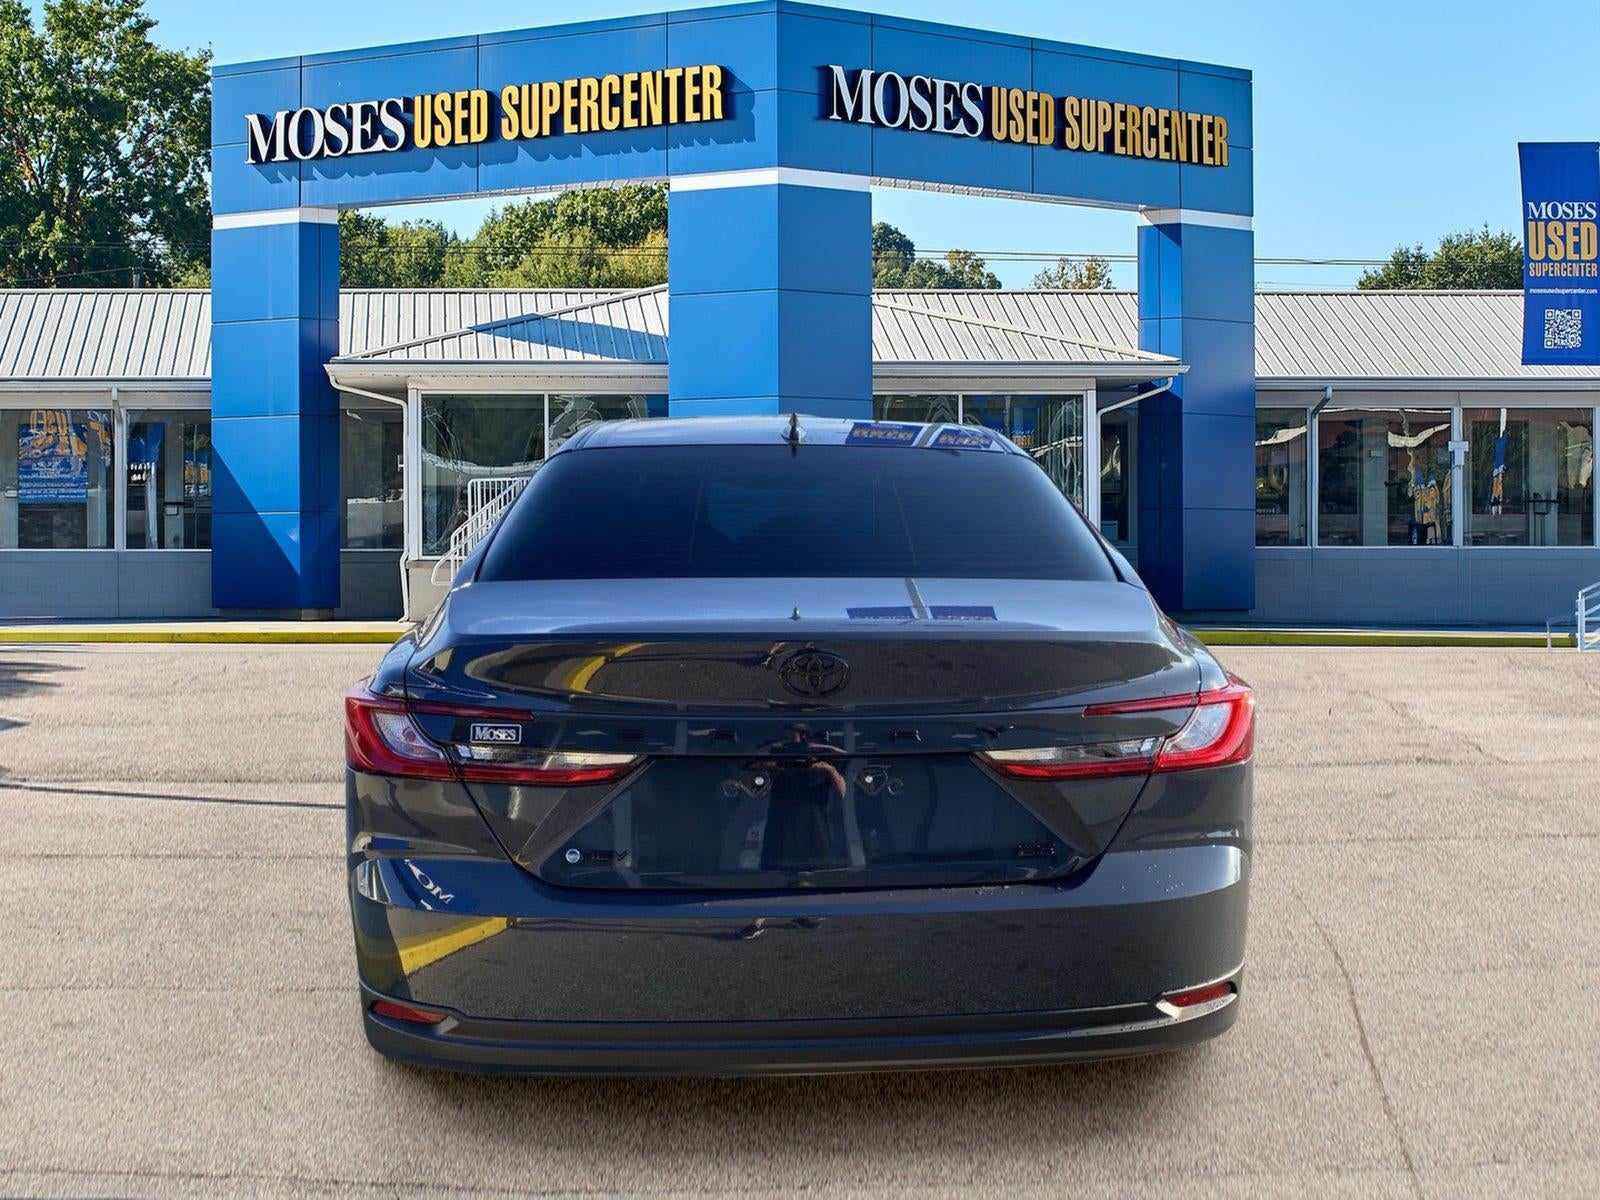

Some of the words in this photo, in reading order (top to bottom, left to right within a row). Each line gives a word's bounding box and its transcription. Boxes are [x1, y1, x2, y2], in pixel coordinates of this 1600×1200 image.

[244, 98, 408, 164] MOSES
[414, 89, 489, 149] USED
[500, 64, 724, 141] SUPERCENTER
[828, 64, 985, 137] MOSES
[991, 86, 1055, 146] USED
[1064, 96, 1229, 167] SUPERCENTER
[1527, 201, 1597, 220] MOSES
[1528, 221, 1598, 261] USED
[1529, 262, 1598, 277] SUPERCENTER
